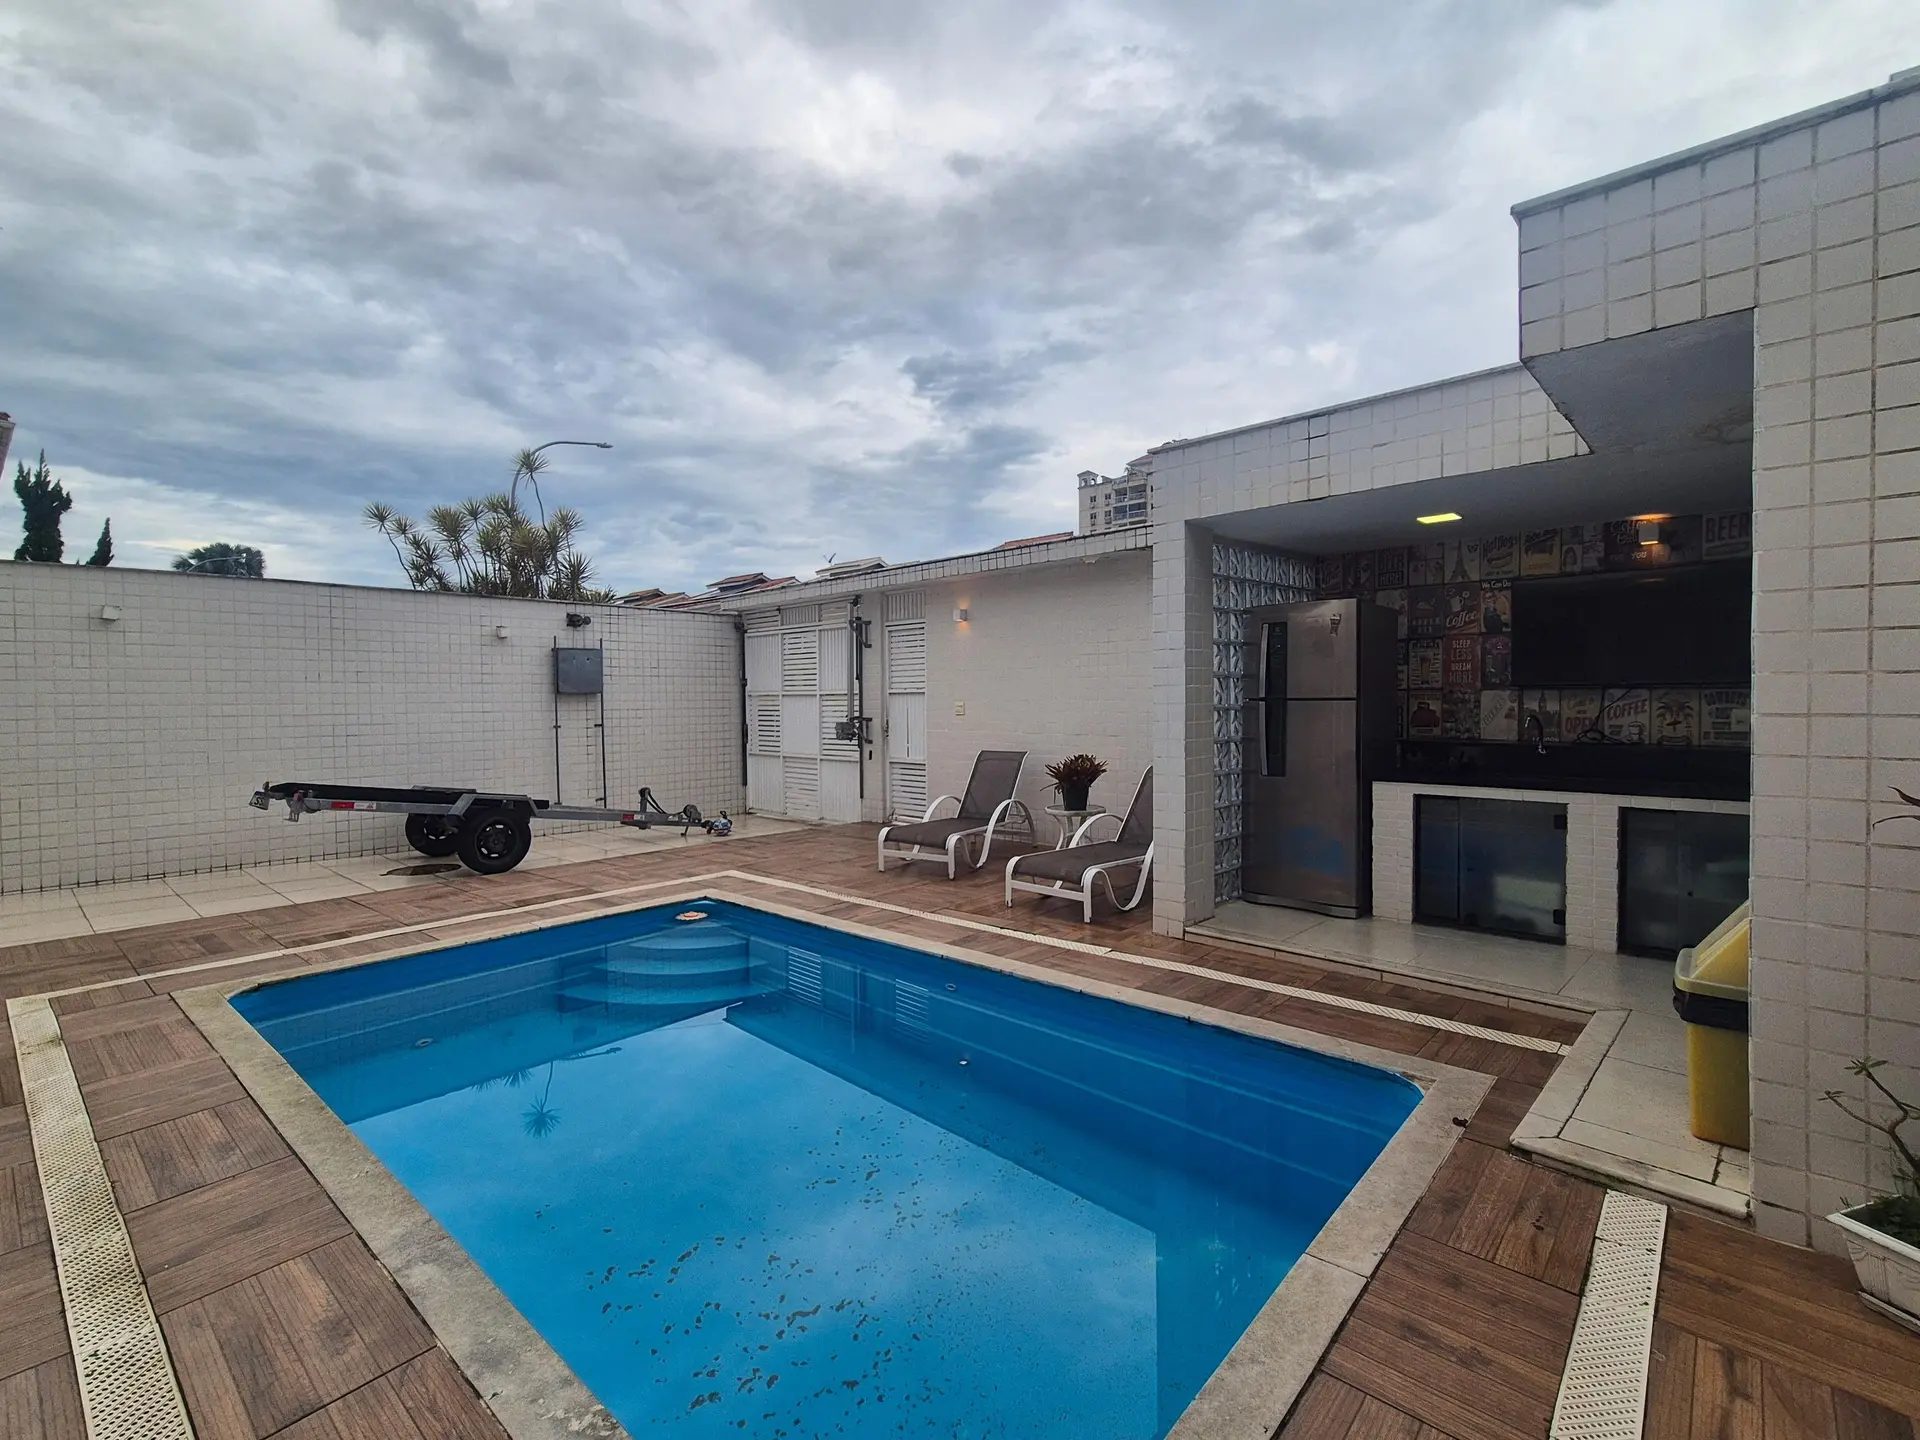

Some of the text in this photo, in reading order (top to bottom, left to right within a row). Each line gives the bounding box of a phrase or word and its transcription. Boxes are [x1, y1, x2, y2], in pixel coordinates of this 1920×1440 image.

[1446, 610, 1478, 628] Coffee
[1452, 639, 1471, 648] SLEEP
[1450, 648, 1472, 660] LESS
[1450, 662, 1472, 671] DREAM
[1449, 671, 1473, 684] MORE
[1606, 698, 1648, 721] COFFEE
